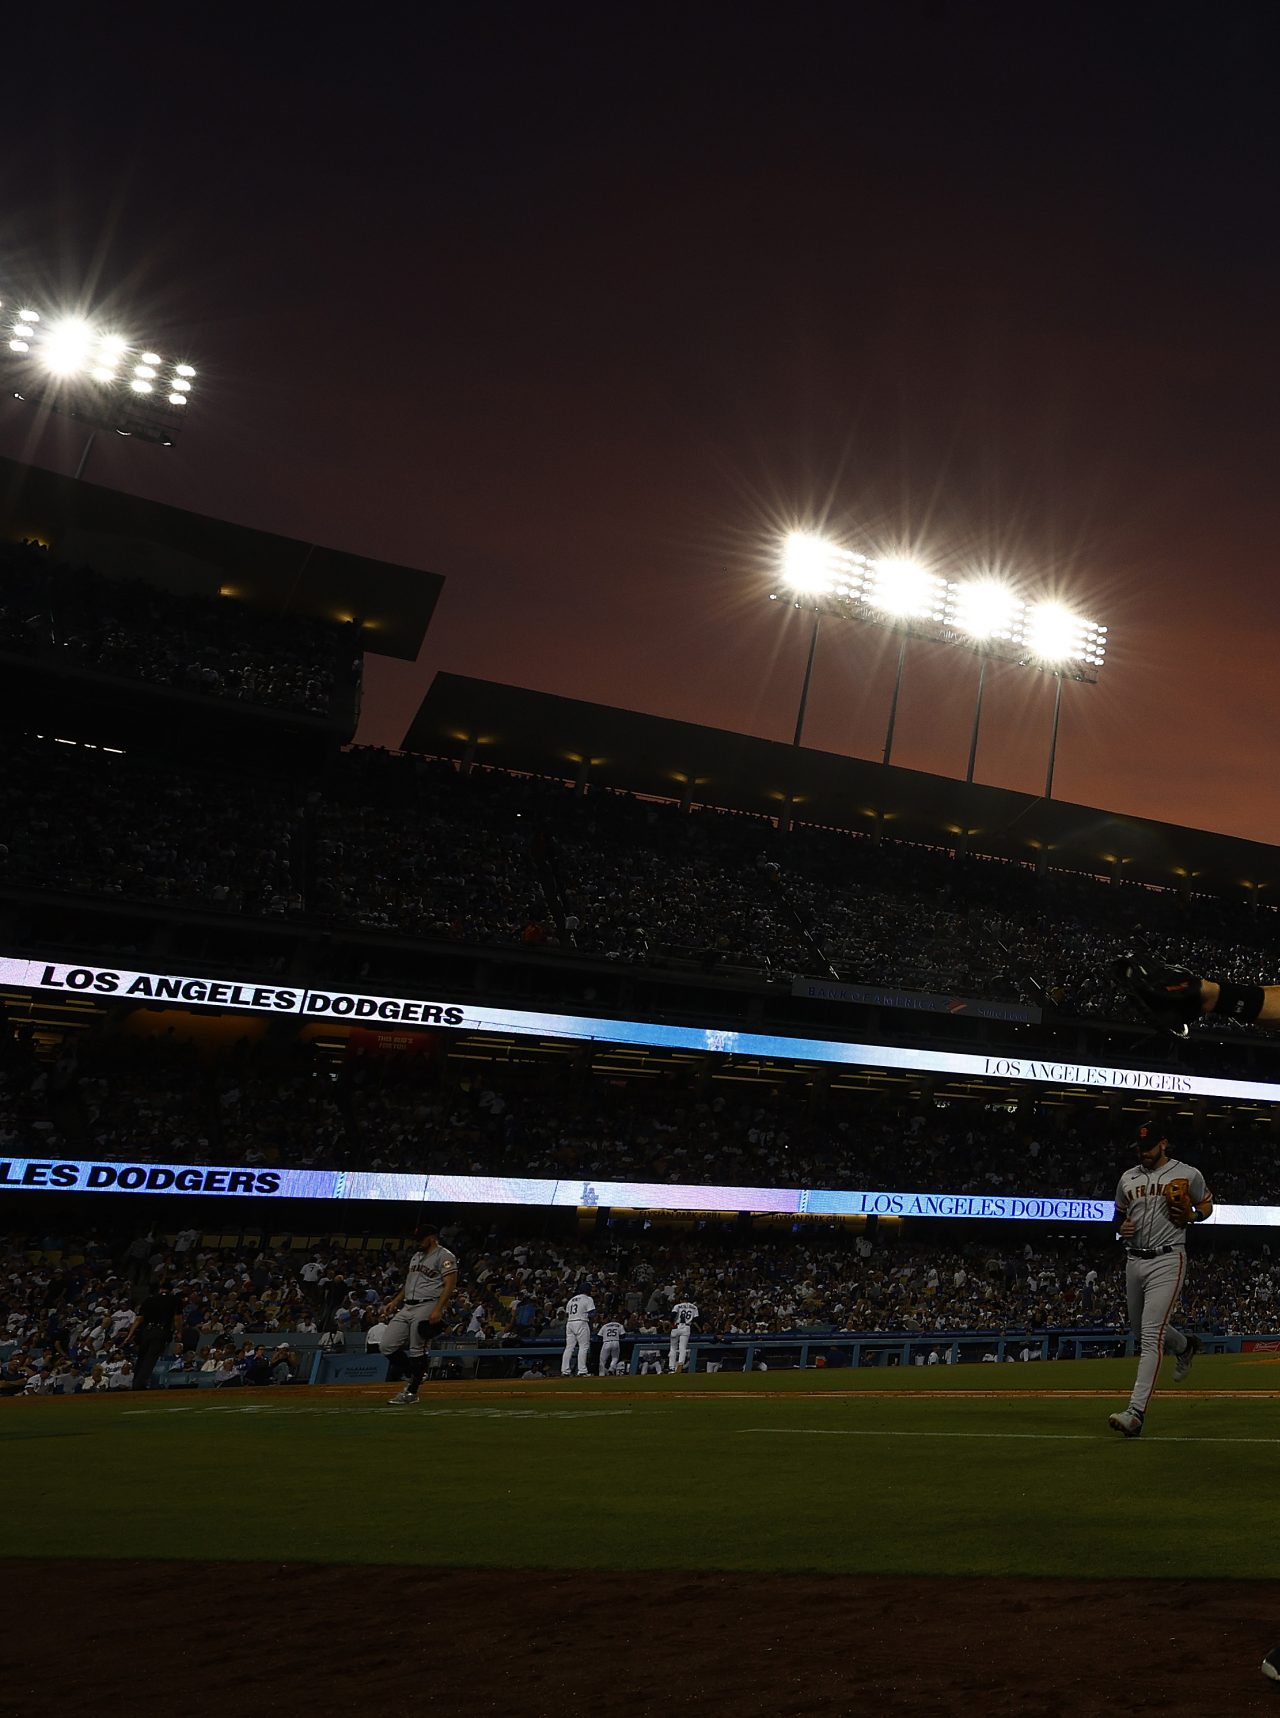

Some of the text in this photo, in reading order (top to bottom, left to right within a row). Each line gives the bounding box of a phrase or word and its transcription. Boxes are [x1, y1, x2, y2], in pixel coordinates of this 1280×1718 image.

[40, 965, 466, 1026] LOS ANGELES DODGERS
[985, 1058, 1192, 1092] LOS ANGELES DODGERS
[0, 1162, 281, 1194] LES DODGERS
[860, 1194, 1105, 1220] LOS ANGELES DODGERS
[569, 1303, 579, 1315] 13
[606, 1328, 618, 1337] 25
